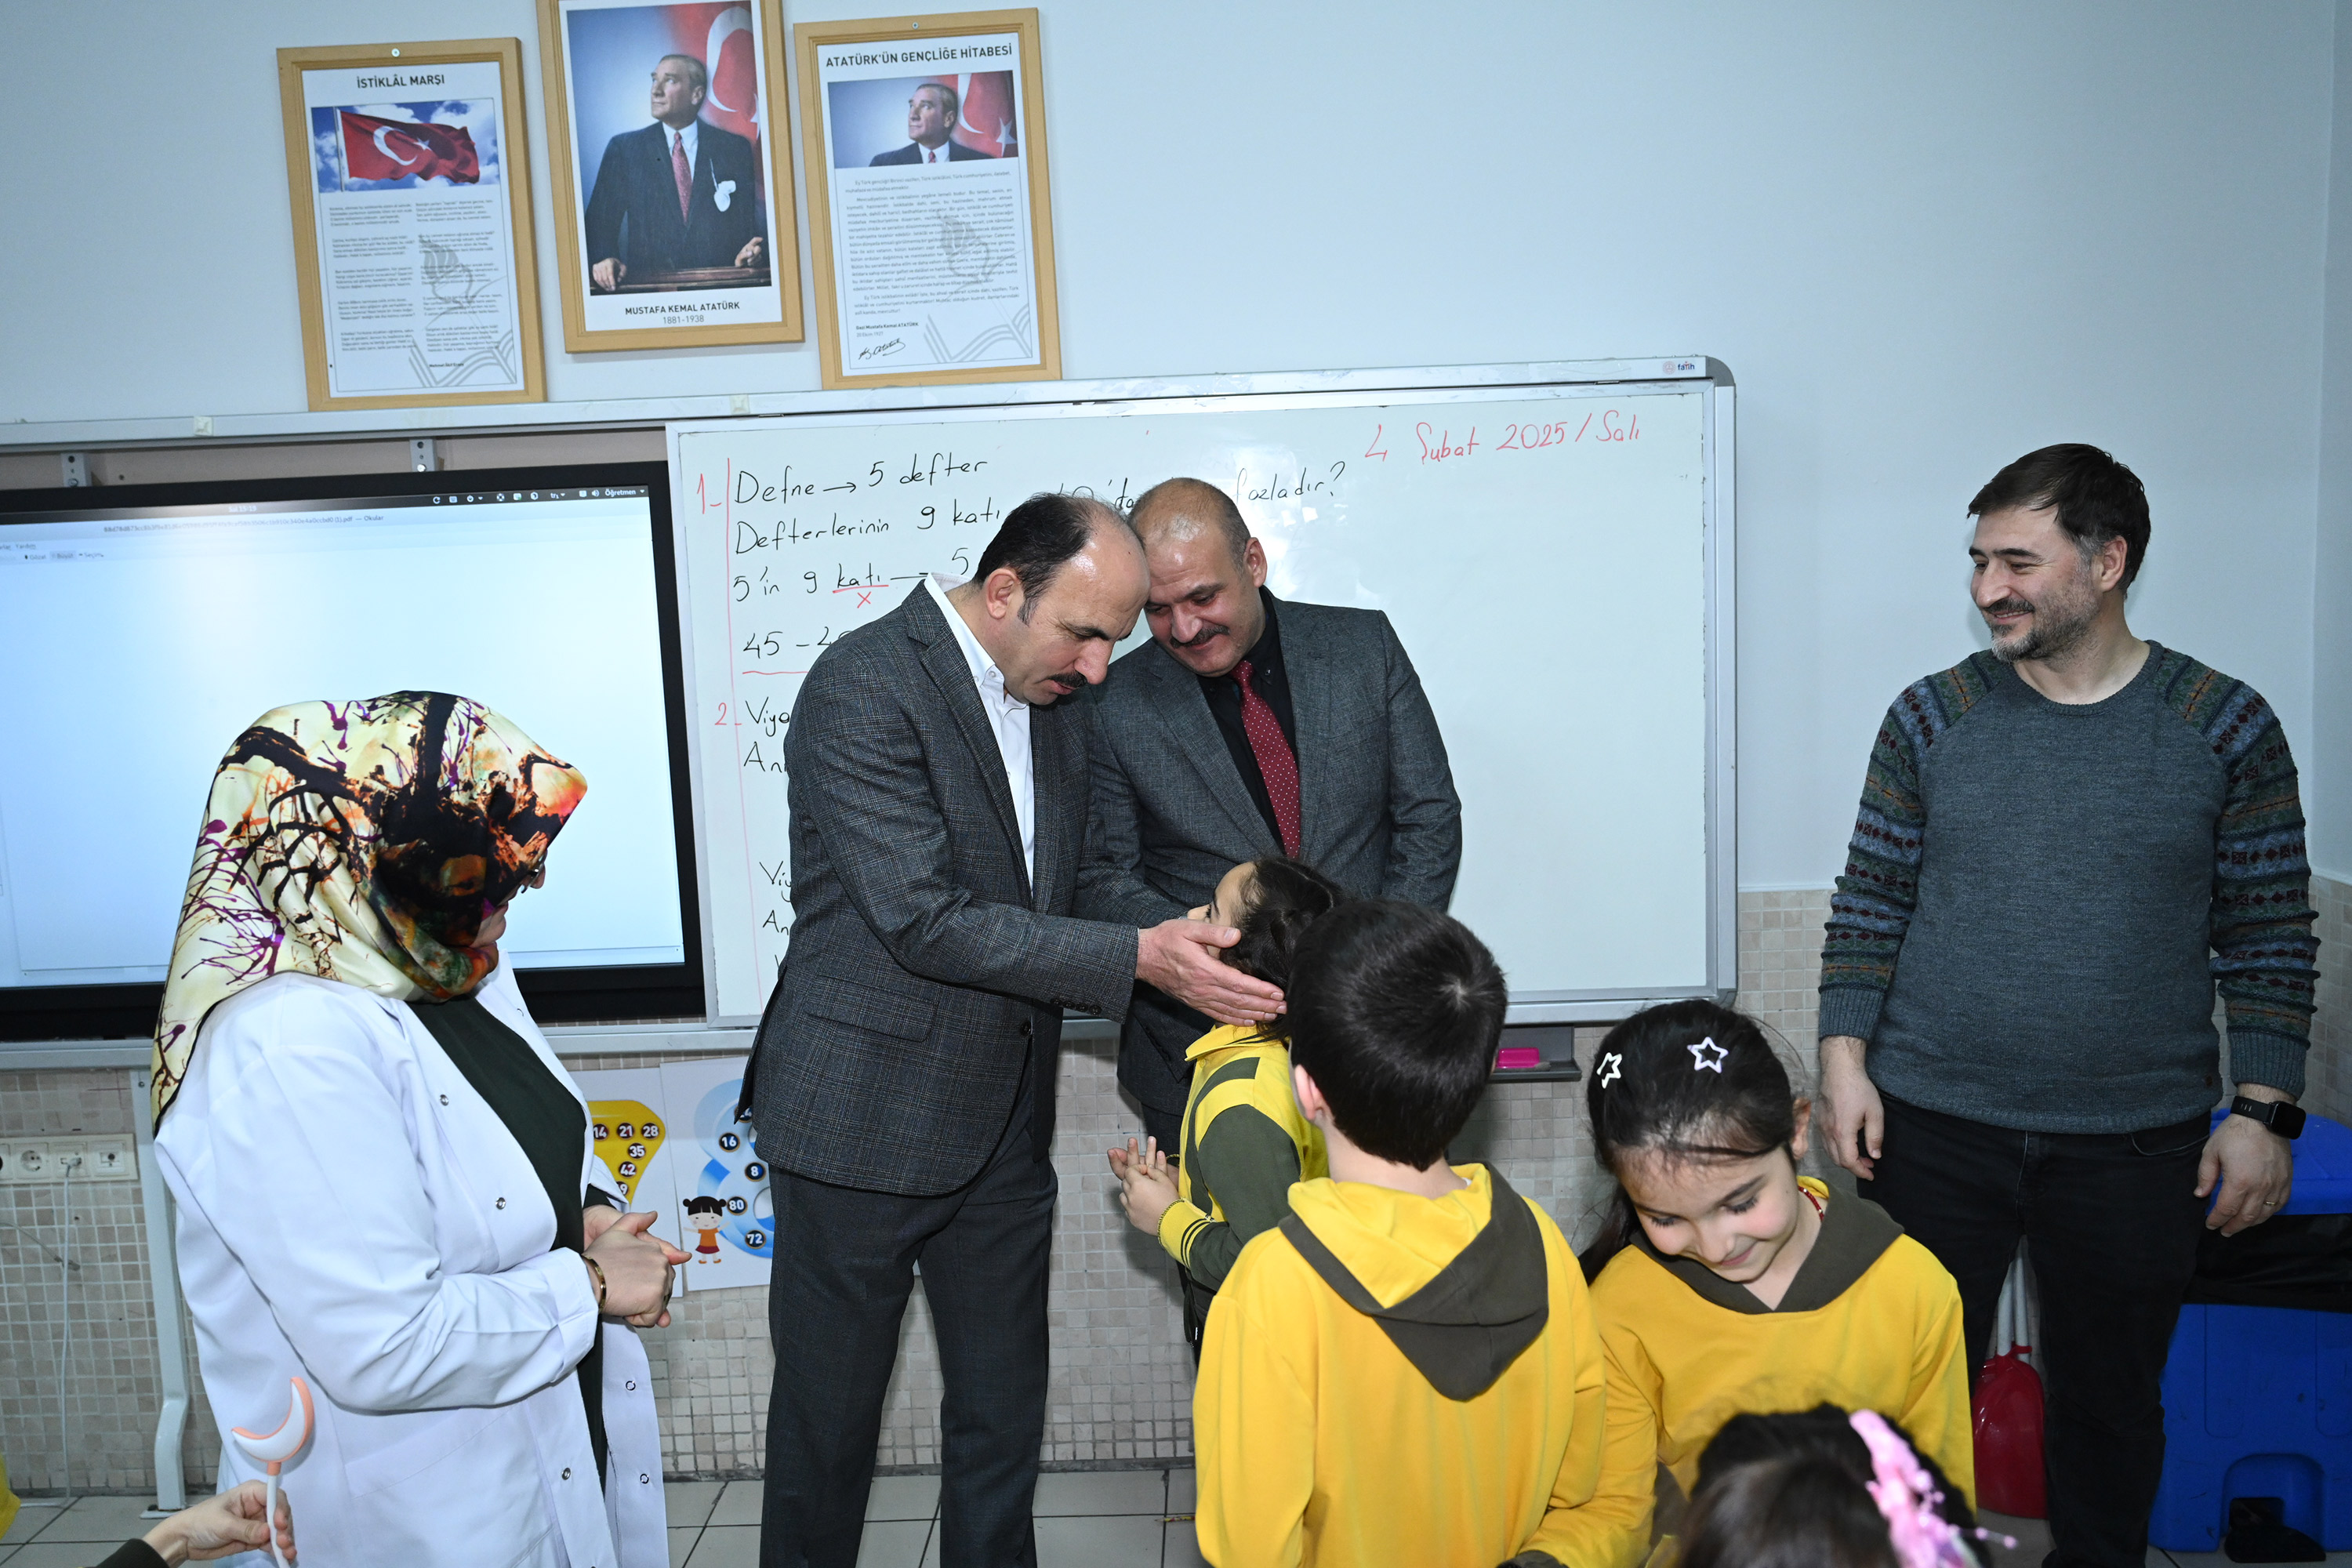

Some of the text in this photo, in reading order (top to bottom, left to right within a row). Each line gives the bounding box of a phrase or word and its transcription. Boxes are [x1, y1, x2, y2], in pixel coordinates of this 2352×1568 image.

[826, 42, 1012, 67] ATATÜRK'ÜN GENÇLİĞE HİTABESİ
[358, 74, 445, 89] İSTİKLÂL MARŞI
[626, 300, 739, 315] MUSTAFA KEMAL ATATÜRK
[663, 315, 704, 325] 1881-1938
[1364, 424, 1388, 461] 4
[1417, 422, 1479, 465] Şubat
[735, 466, 815, 504] Defne
[869, 461, 884, 487] 5
[900, 452, 988, 486] defter
[604, 488, 636, 498] Öğretmen
[737, 513, 889, 554] Defterlerinin
[837, 563, 880, 588] katı
[743, 631, 783, 659] 45
[593, 1126, 659, 1138] 14 21 28
[722, 1136, 736, 1147] 16
[630, 1145, 645, 1156] 35
[620, 1164, 636, 1175] 42
[750, 1166, 759, 1177] 8
[619, 1184, 628, 1194] 9
[729, 1200, 744, 1210] 80
[747, 1233, 762, 1244] 72
